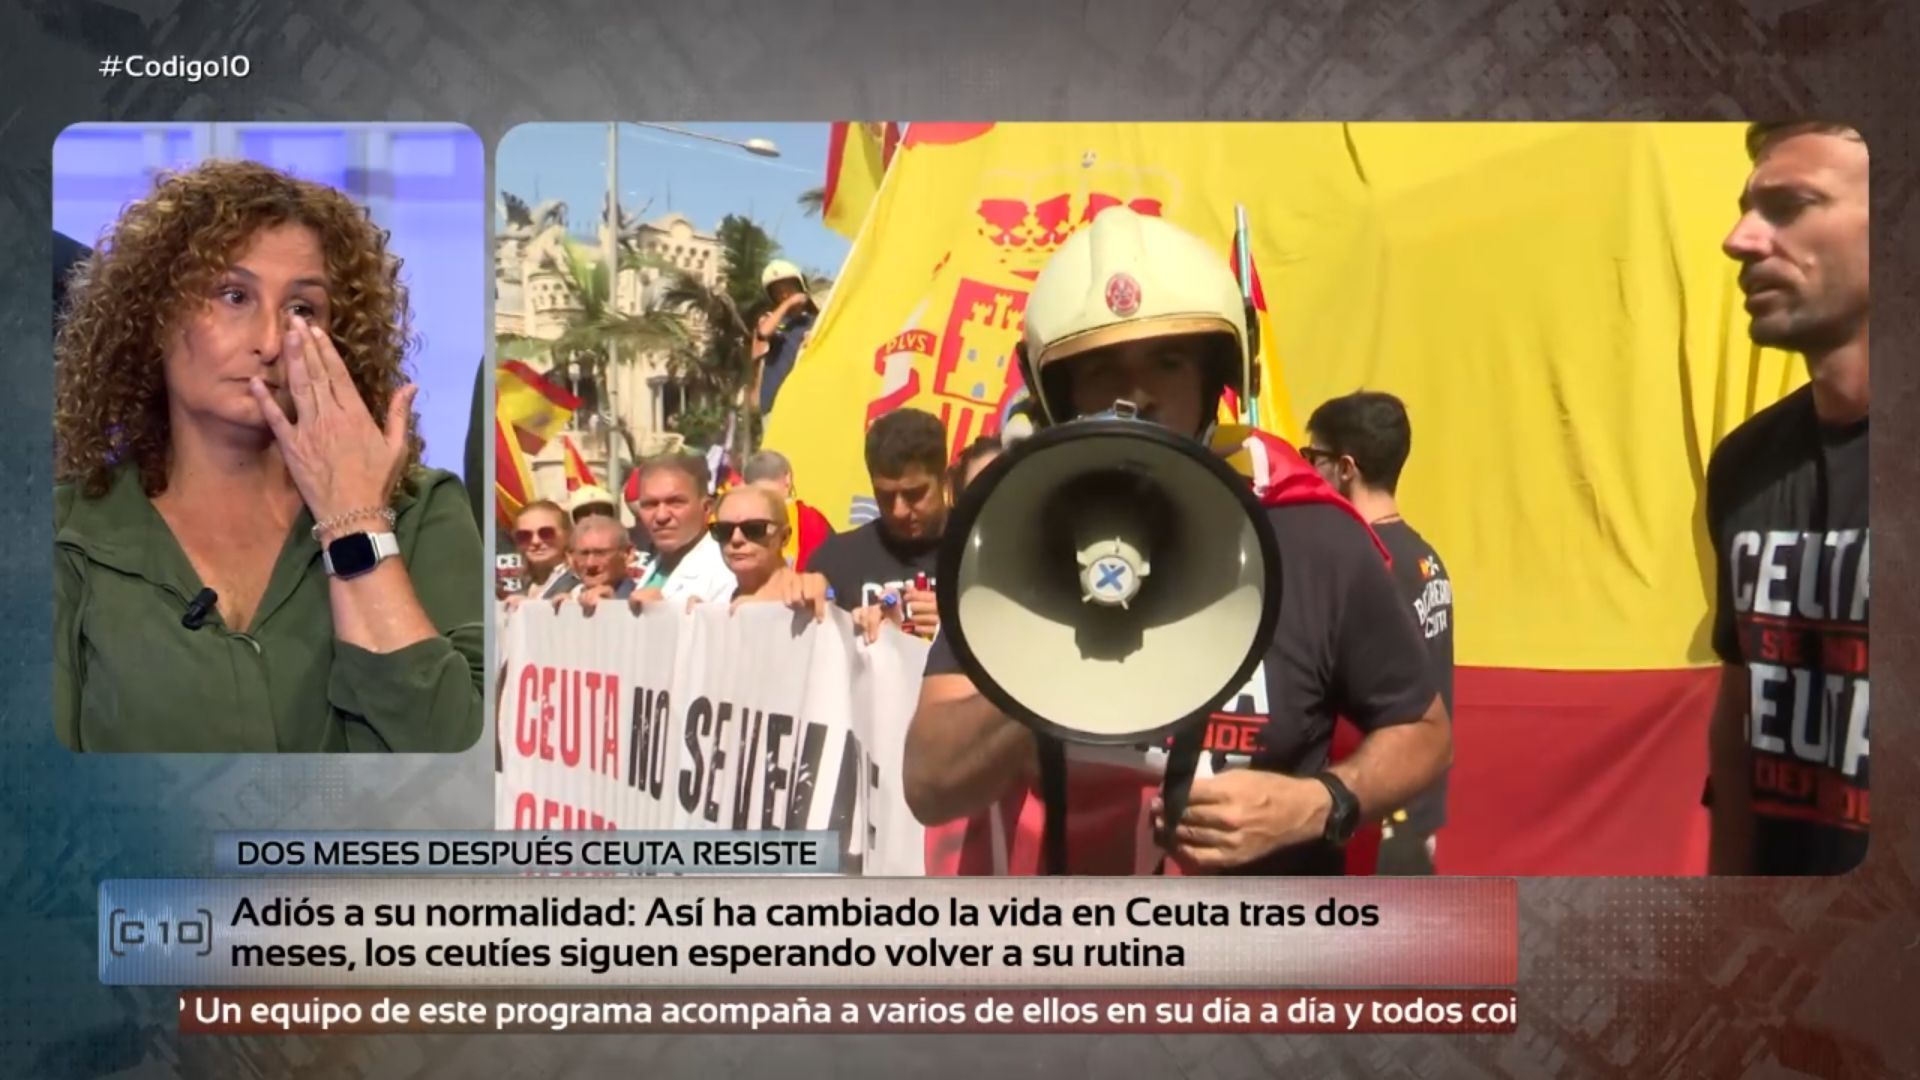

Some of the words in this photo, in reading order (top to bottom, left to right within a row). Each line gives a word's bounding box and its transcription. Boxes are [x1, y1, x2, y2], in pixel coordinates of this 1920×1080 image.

[515, 664, 619, 781] CEUTA
[628, 686, 670, 801] NO
[678, 696, 733, 824] SE
